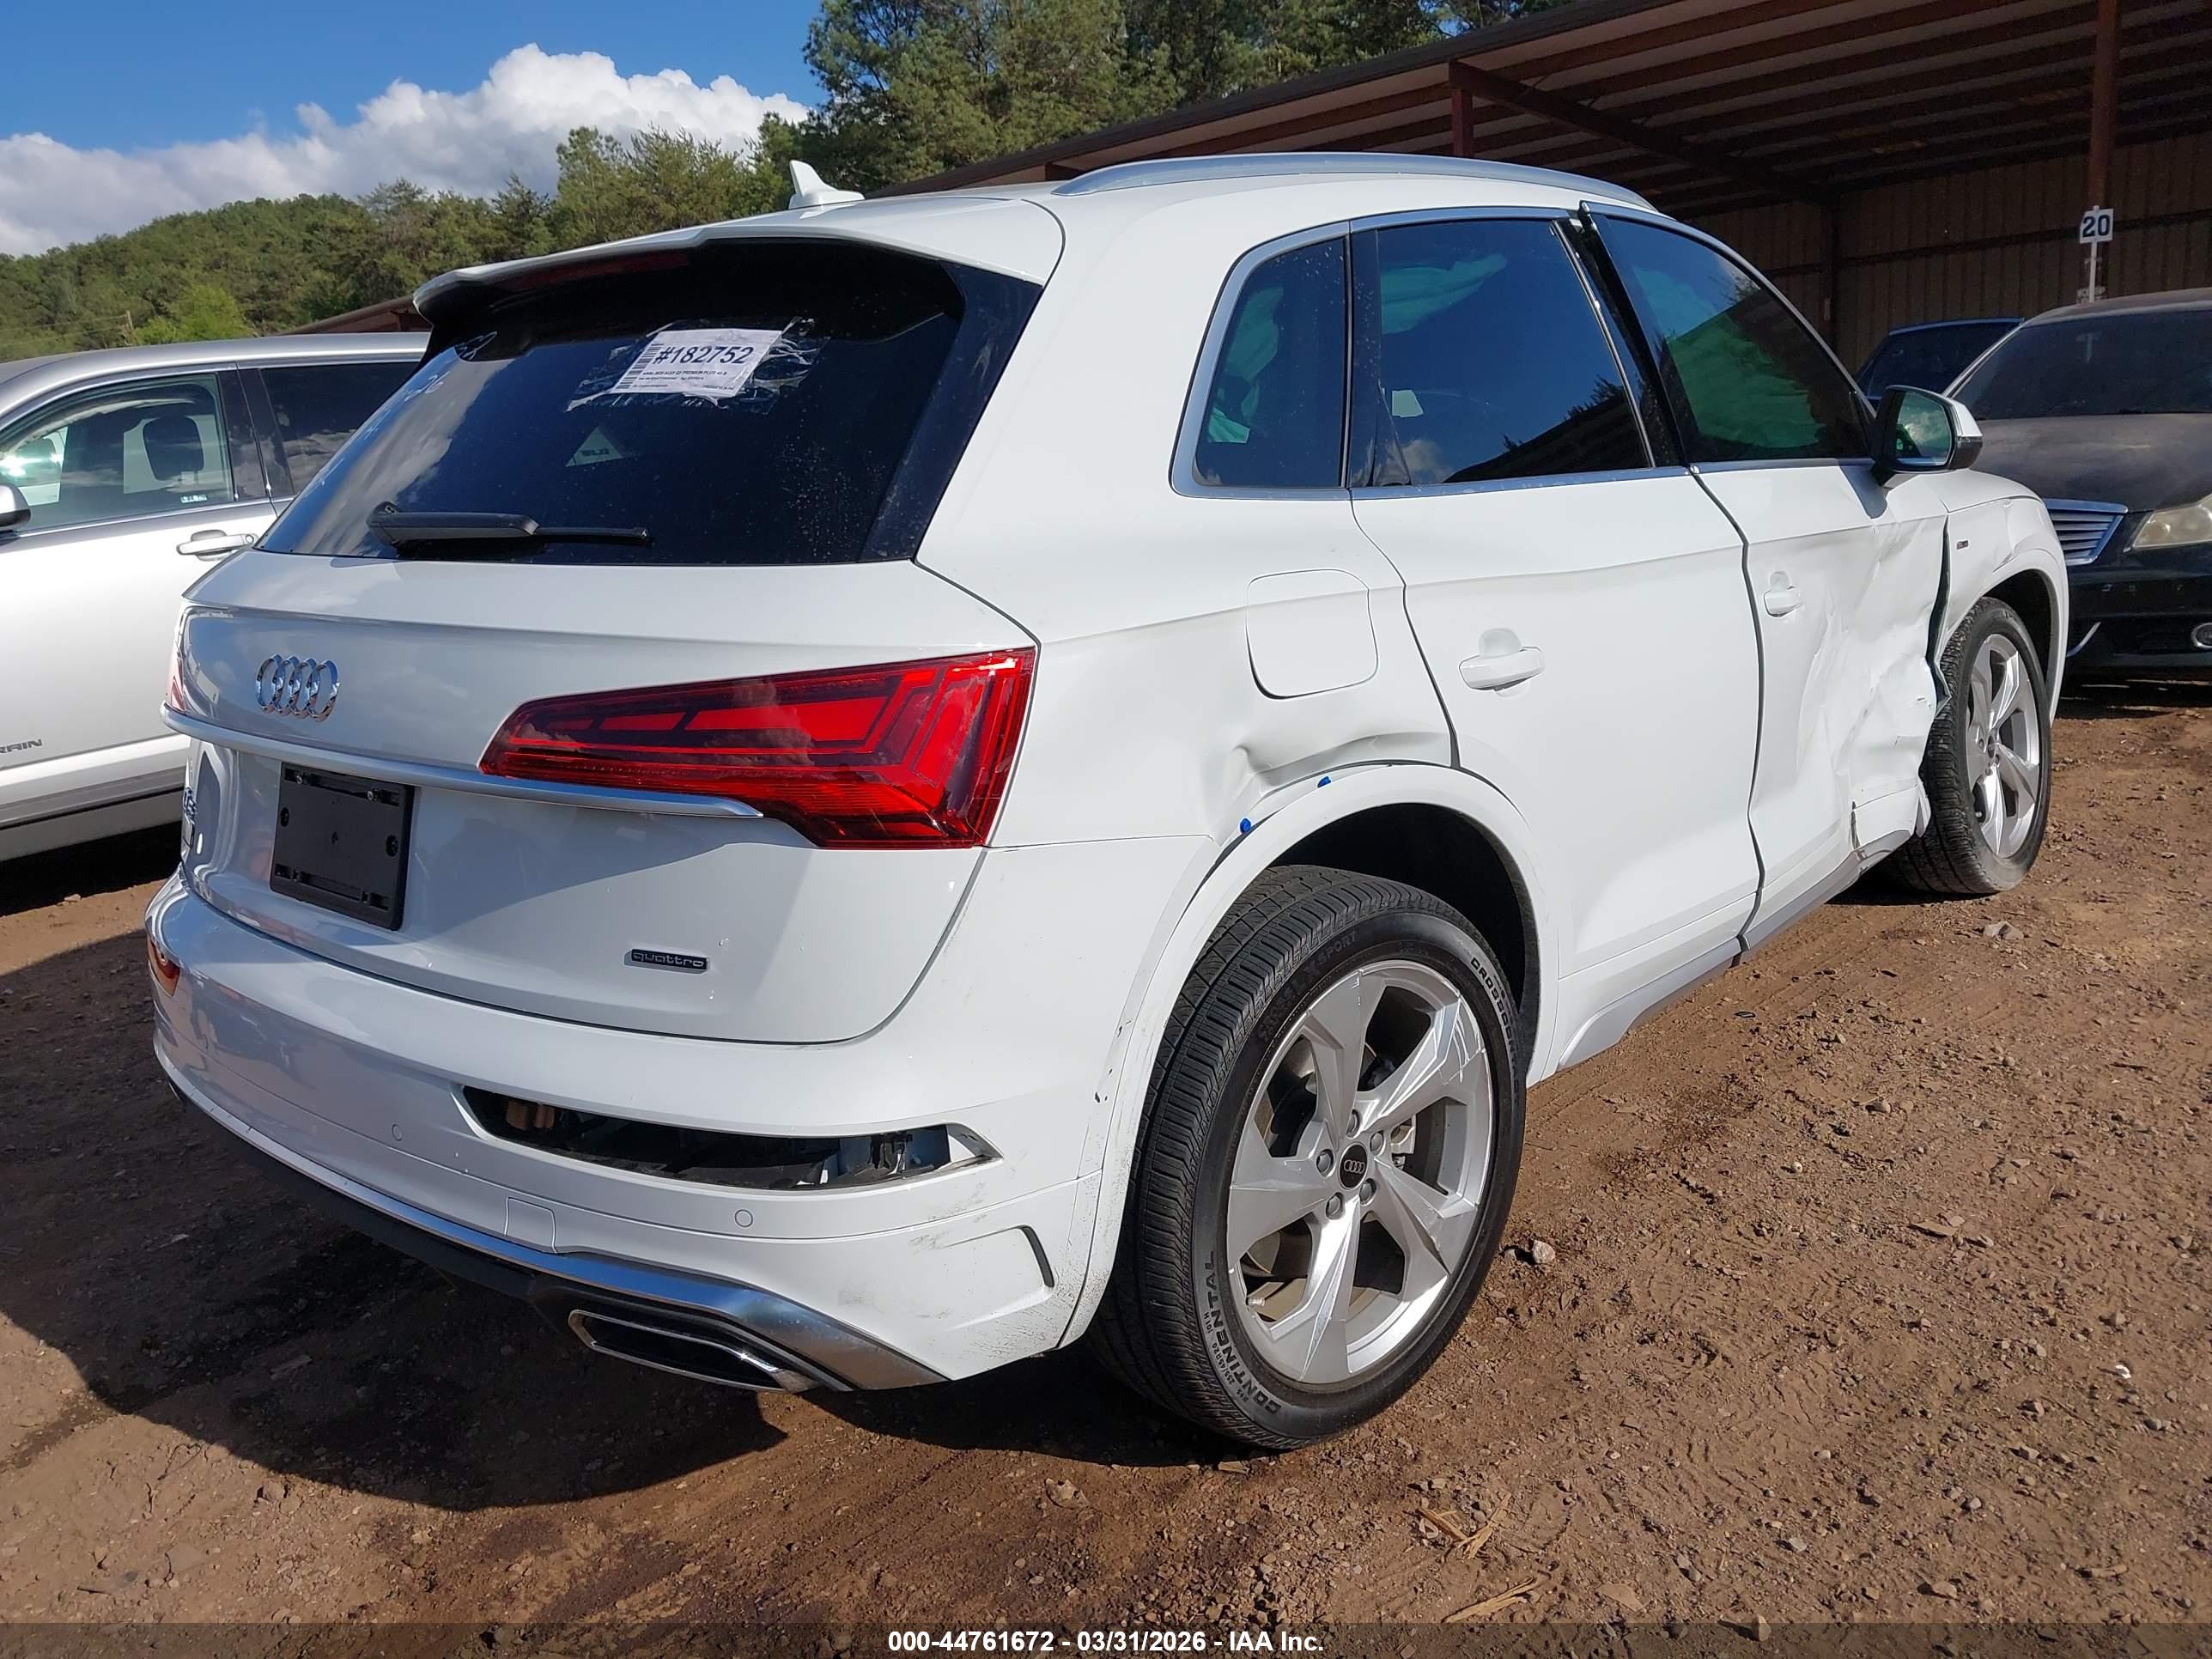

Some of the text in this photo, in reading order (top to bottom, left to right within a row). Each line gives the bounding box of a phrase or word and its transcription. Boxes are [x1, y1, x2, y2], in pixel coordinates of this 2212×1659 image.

[2082, 215, 2111, 237] 20
[653, 345, 754, 365] #182752
[632, 952, 704, 967] quattro
[1204, 1250, 1282, 1414] CONTINENTAL
